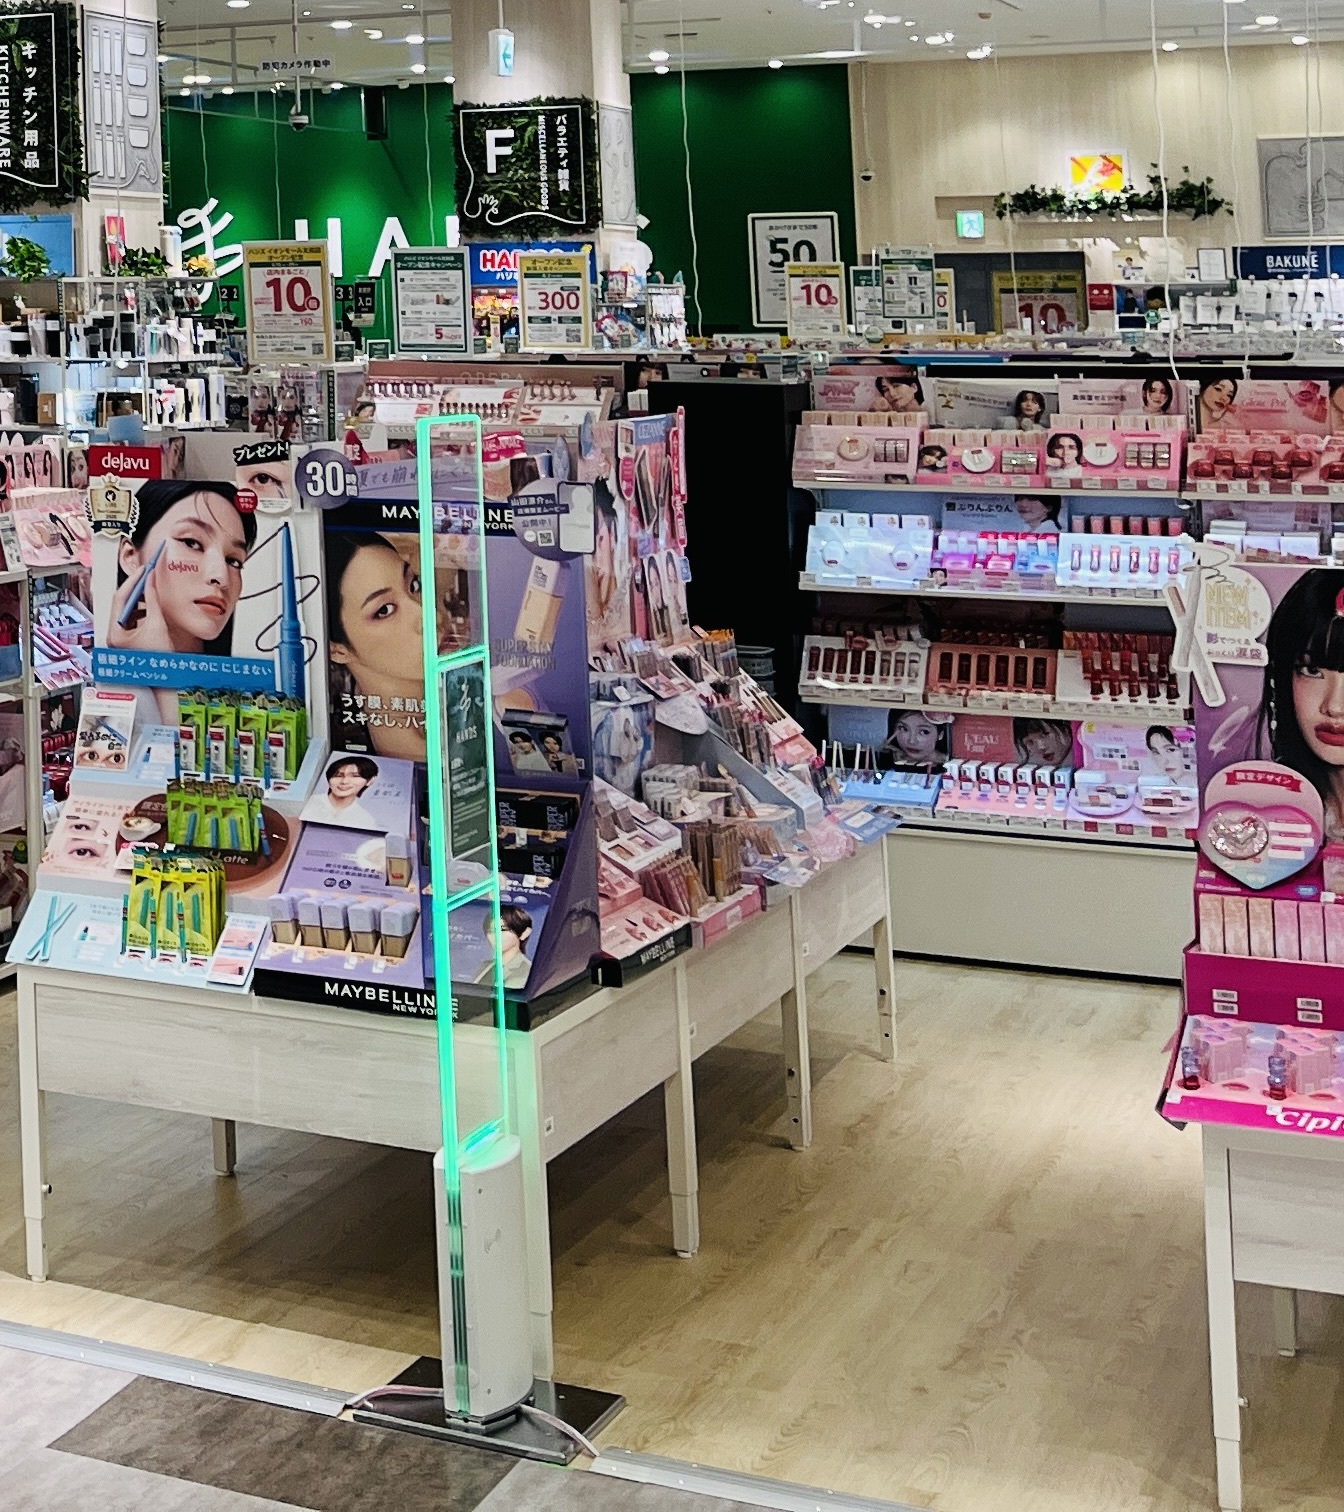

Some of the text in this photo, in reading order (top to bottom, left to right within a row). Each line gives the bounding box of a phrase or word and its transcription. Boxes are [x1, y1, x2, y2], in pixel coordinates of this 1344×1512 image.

[262, 60, 331, 71] 防犯カメラ作動中
[22, 42, 40, 169] キッチン用品
[486, 129, 514, 173] F
[1265, 255, 1319, 269] BAKUNE
[265, 277, 312, 312] 10
[538, 292, 579, 310] 300
[102, 452, 150, 471] dejavu
[234, 442, 289, 463] プレゼント!
[306, 461, 344, 497] 30
[382, 504, 513, 524] MAYBELLNE
[168, 561, 199, 573] dejavu
[149, 657, 218, 672] なめらかなのに
[221, 662, 272, 676] にじまない
[392, 1003, 417, 1013] NEW
[1276, 1111, 1344, 1134] Cipi
